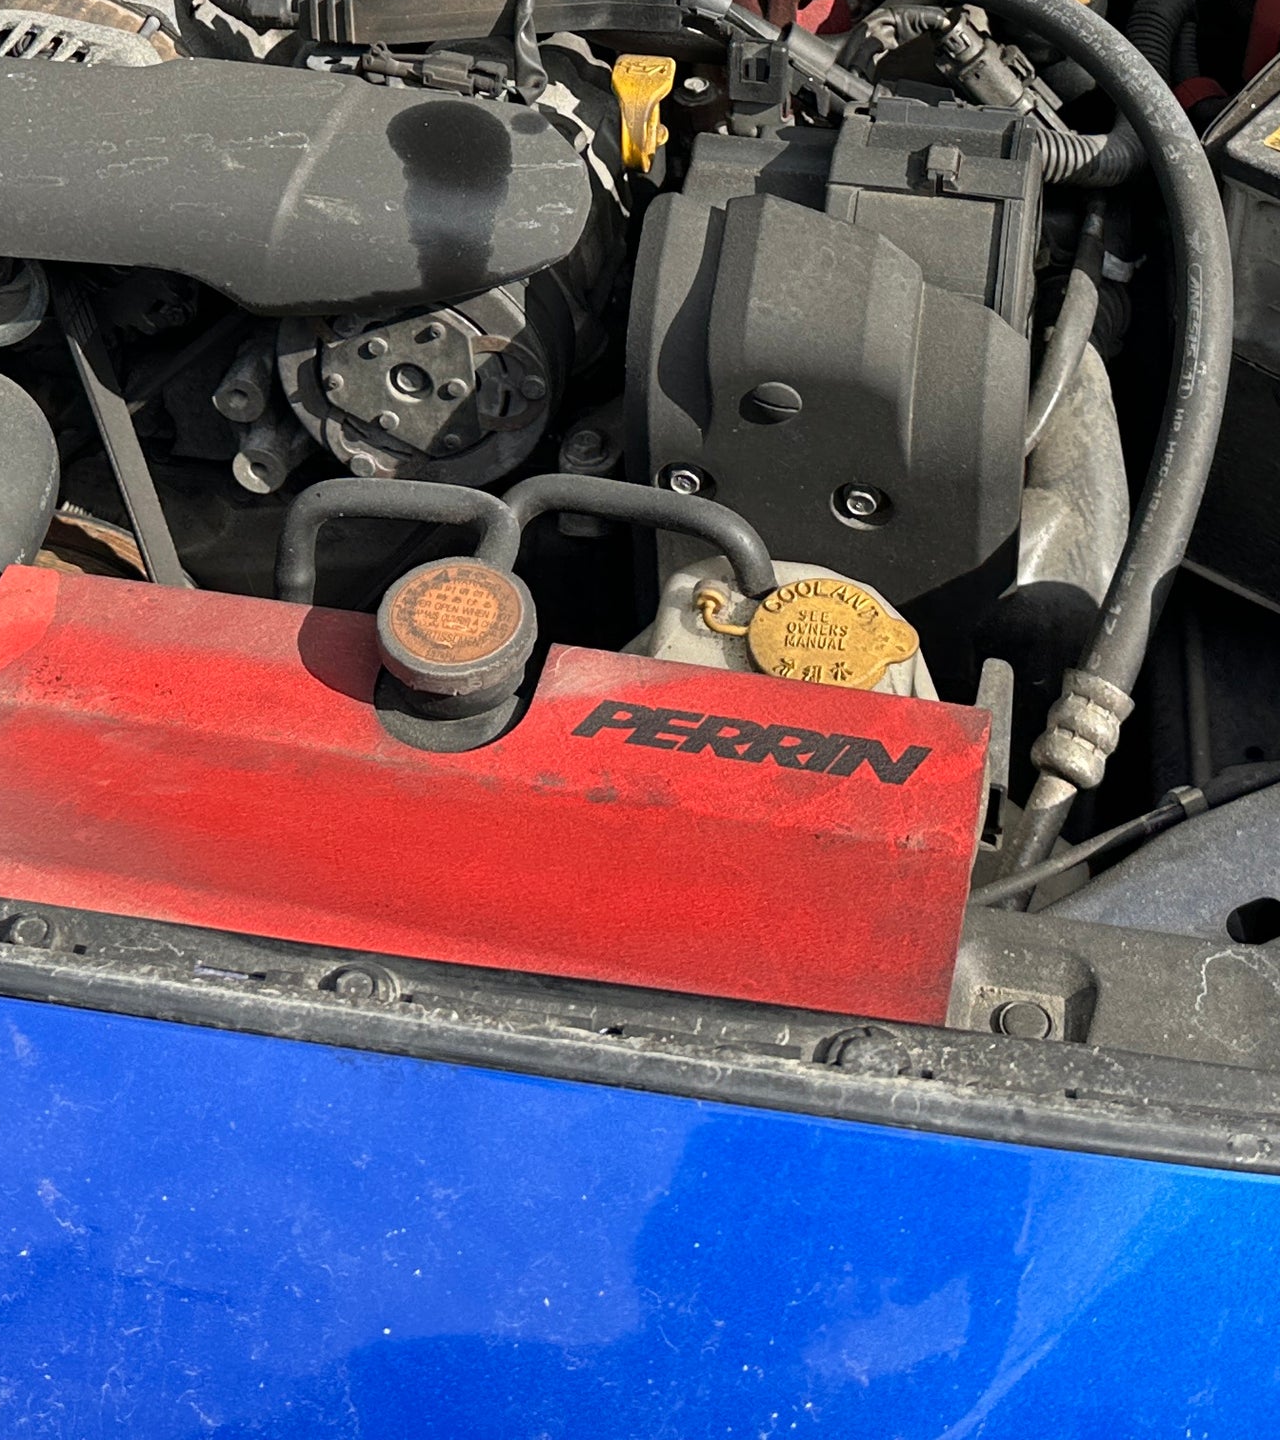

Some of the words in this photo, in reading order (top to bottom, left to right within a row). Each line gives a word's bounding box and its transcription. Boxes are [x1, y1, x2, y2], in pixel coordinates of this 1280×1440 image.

[797, 609, 831, 624] SEE
[783, 634, 847, 652] MANUAL
[570, 698, 934, 786] PERRIN
